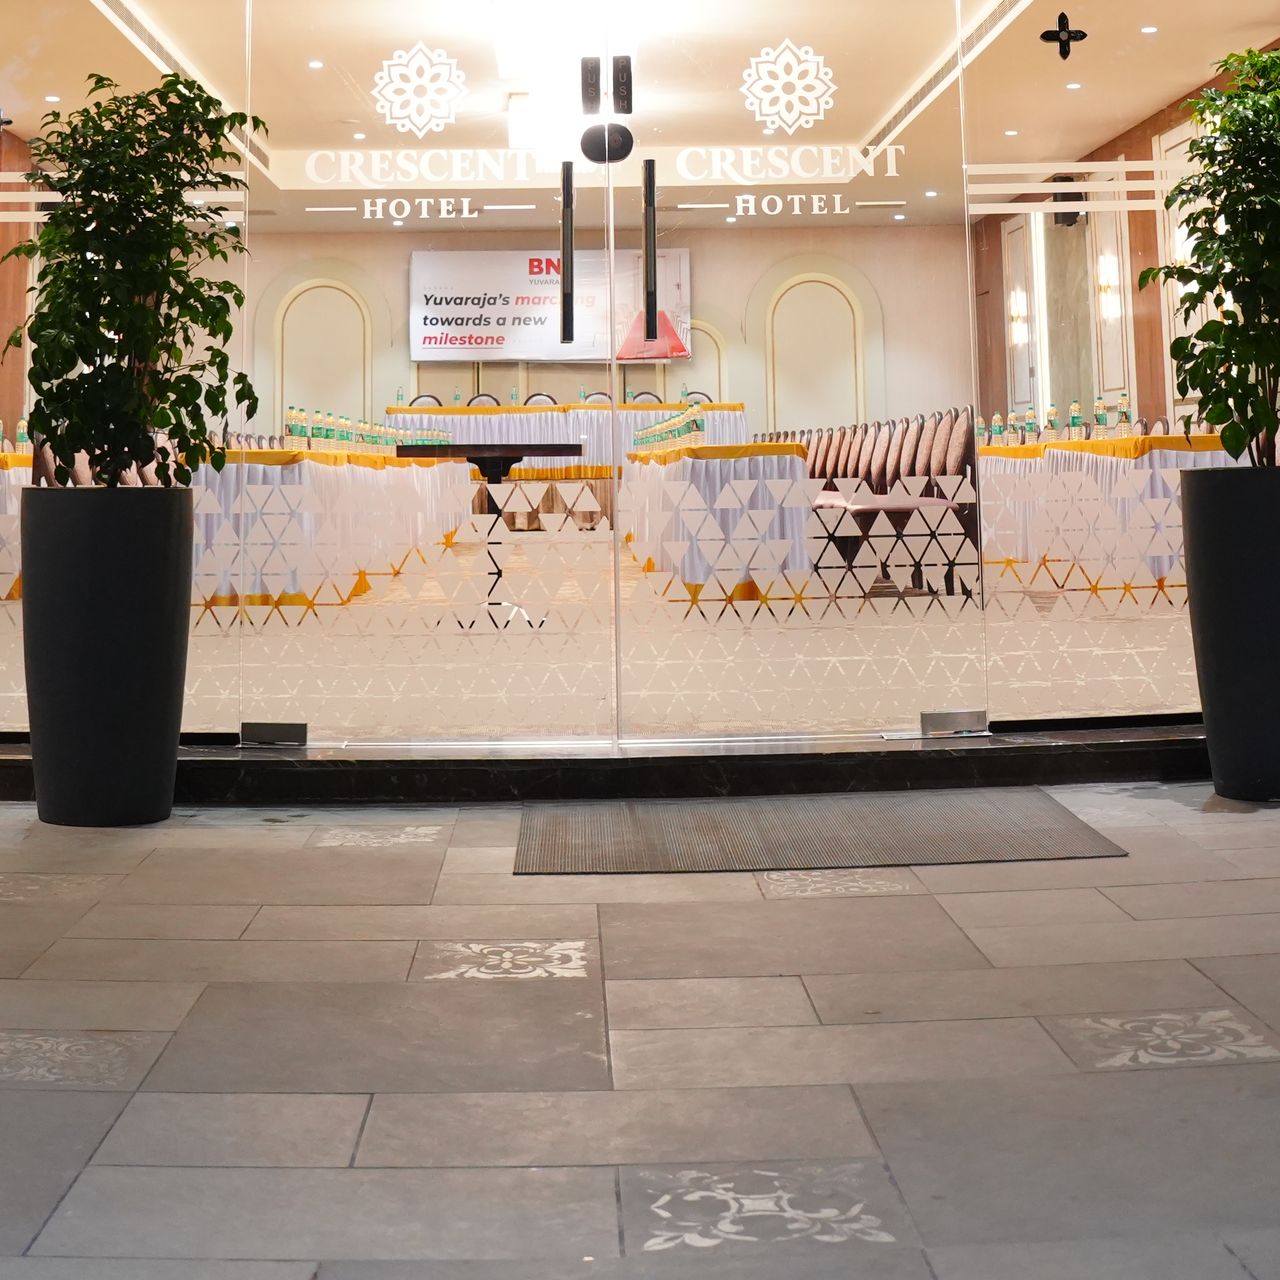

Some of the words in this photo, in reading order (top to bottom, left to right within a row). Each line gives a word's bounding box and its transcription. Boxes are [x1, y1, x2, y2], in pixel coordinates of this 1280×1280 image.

[618, 59, 628, 109] PUSH
[304, 148, 537, 189] CRESCENT
[675, 144, 906, 186] CRESCENT
[362, 197, 479, 219] HOTEL
[735, 194, 850, 216] HOTEL
[528, 257, 561, 276] BN
[528, 278, 561, 286] YUVARA
[423, 292, 511, 309] Yuvaraja’s
[514, 294, 597, 309] marcng
[422, 314, 491, 327] towards
[495, 316, 507, 327] a
[511, 316, 548, 326] new
[422, 332, 506, 346] milestone
